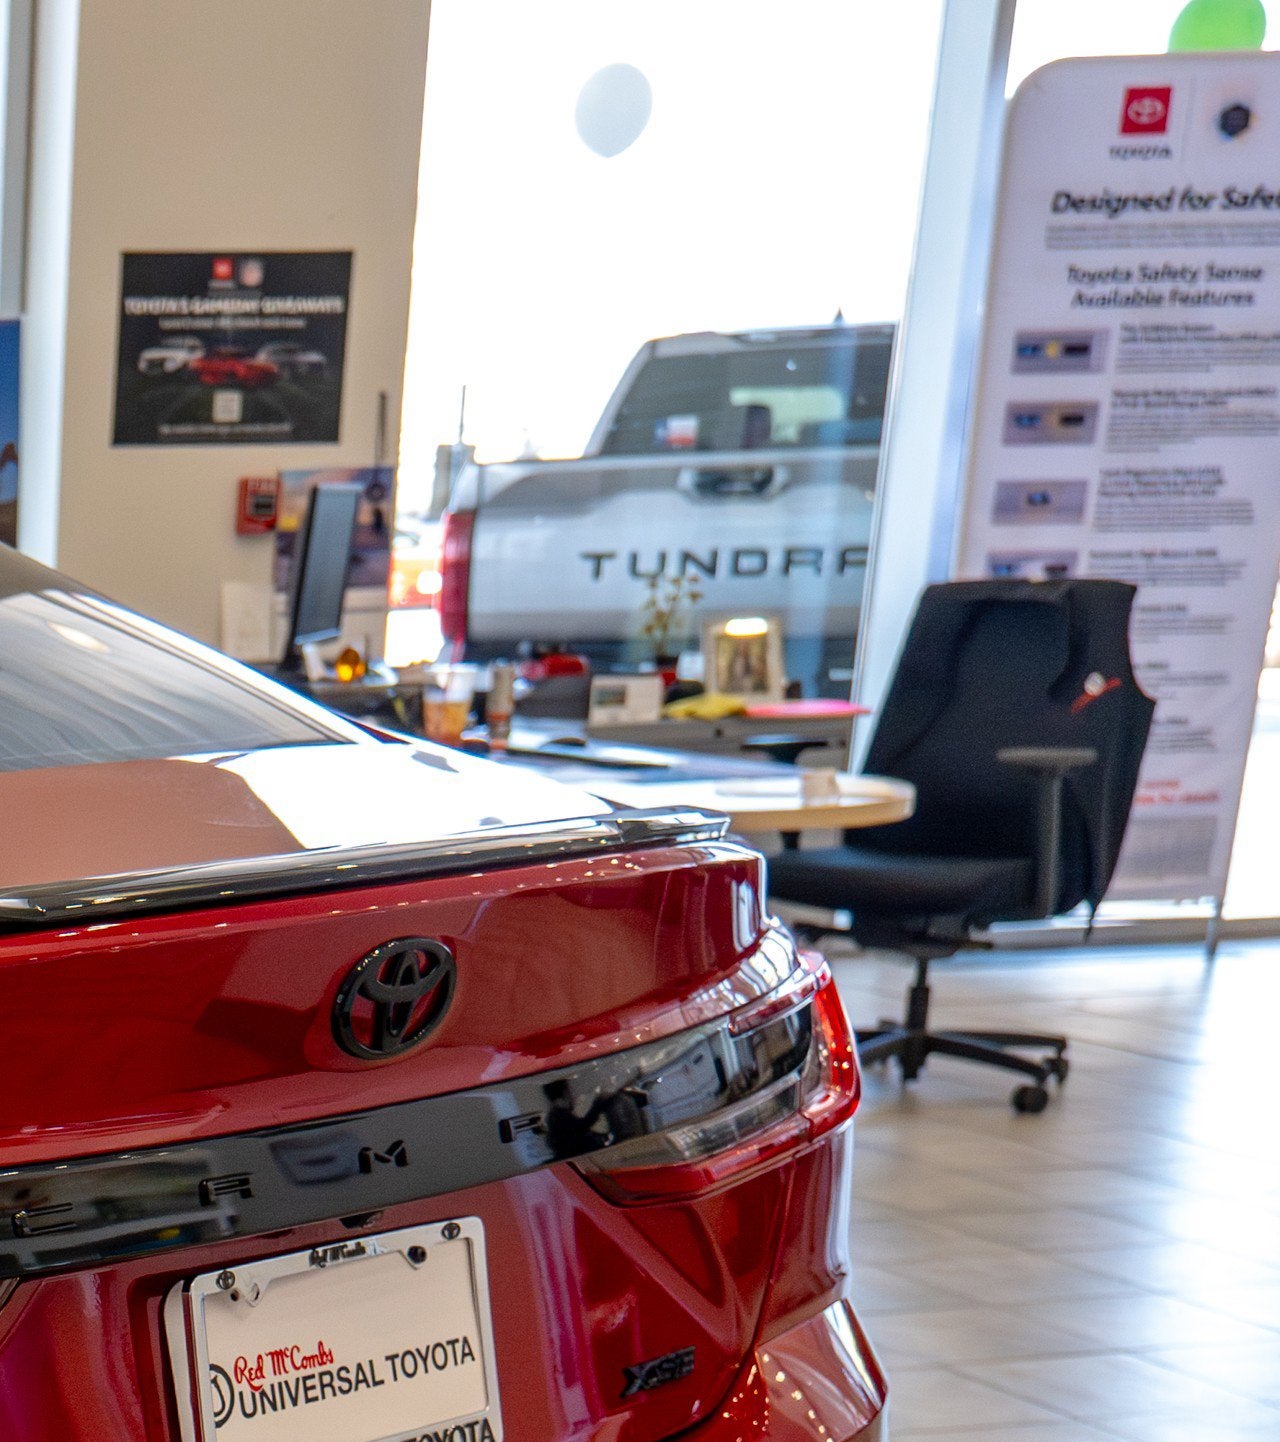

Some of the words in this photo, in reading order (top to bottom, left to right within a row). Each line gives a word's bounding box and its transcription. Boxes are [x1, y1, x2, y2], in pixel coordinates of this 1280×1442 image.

[1051, 186, 1175, 218] Designed
[1178, 184, 1217, 211] for
[1068, 263, 1132, 286] Toyota
[1138, 261, 1199, 285] Safety
[1205, 261, 1263, 282] Sense
[1071, 287, 1164, 308] Available
[1169, 287, 1255, 307] Features
[581, 546, 869, 580] TUNDRA
[234, 1355, 266, 1391] Red
[266, 1340, 334, 1376] McCombs
[239, 1359, 385, 1419] UNIVERSAL
[385, 1336, 476, 1383] TOYOTA
